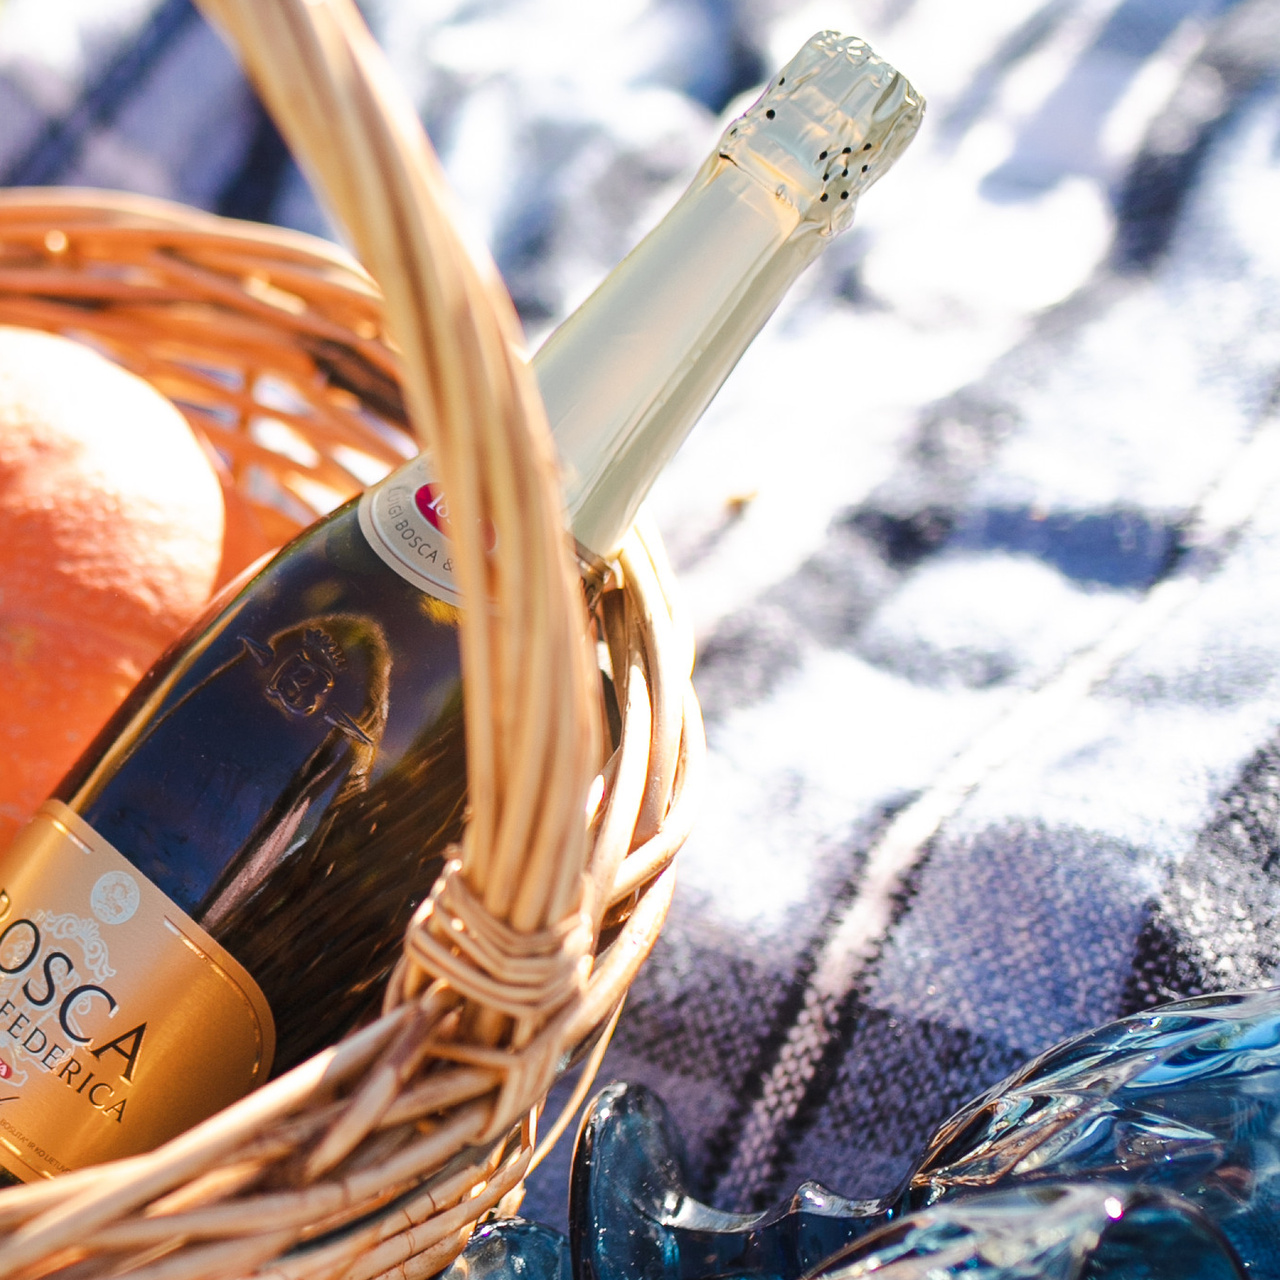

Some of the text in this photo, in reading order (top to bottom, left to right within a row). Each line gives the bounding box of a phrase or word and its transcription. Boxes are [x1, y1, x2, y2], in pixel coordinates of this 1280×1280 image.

[387, 486, 455, 573] LUIGI BOSCA &
[33, 1146, 46, 1158] KO
